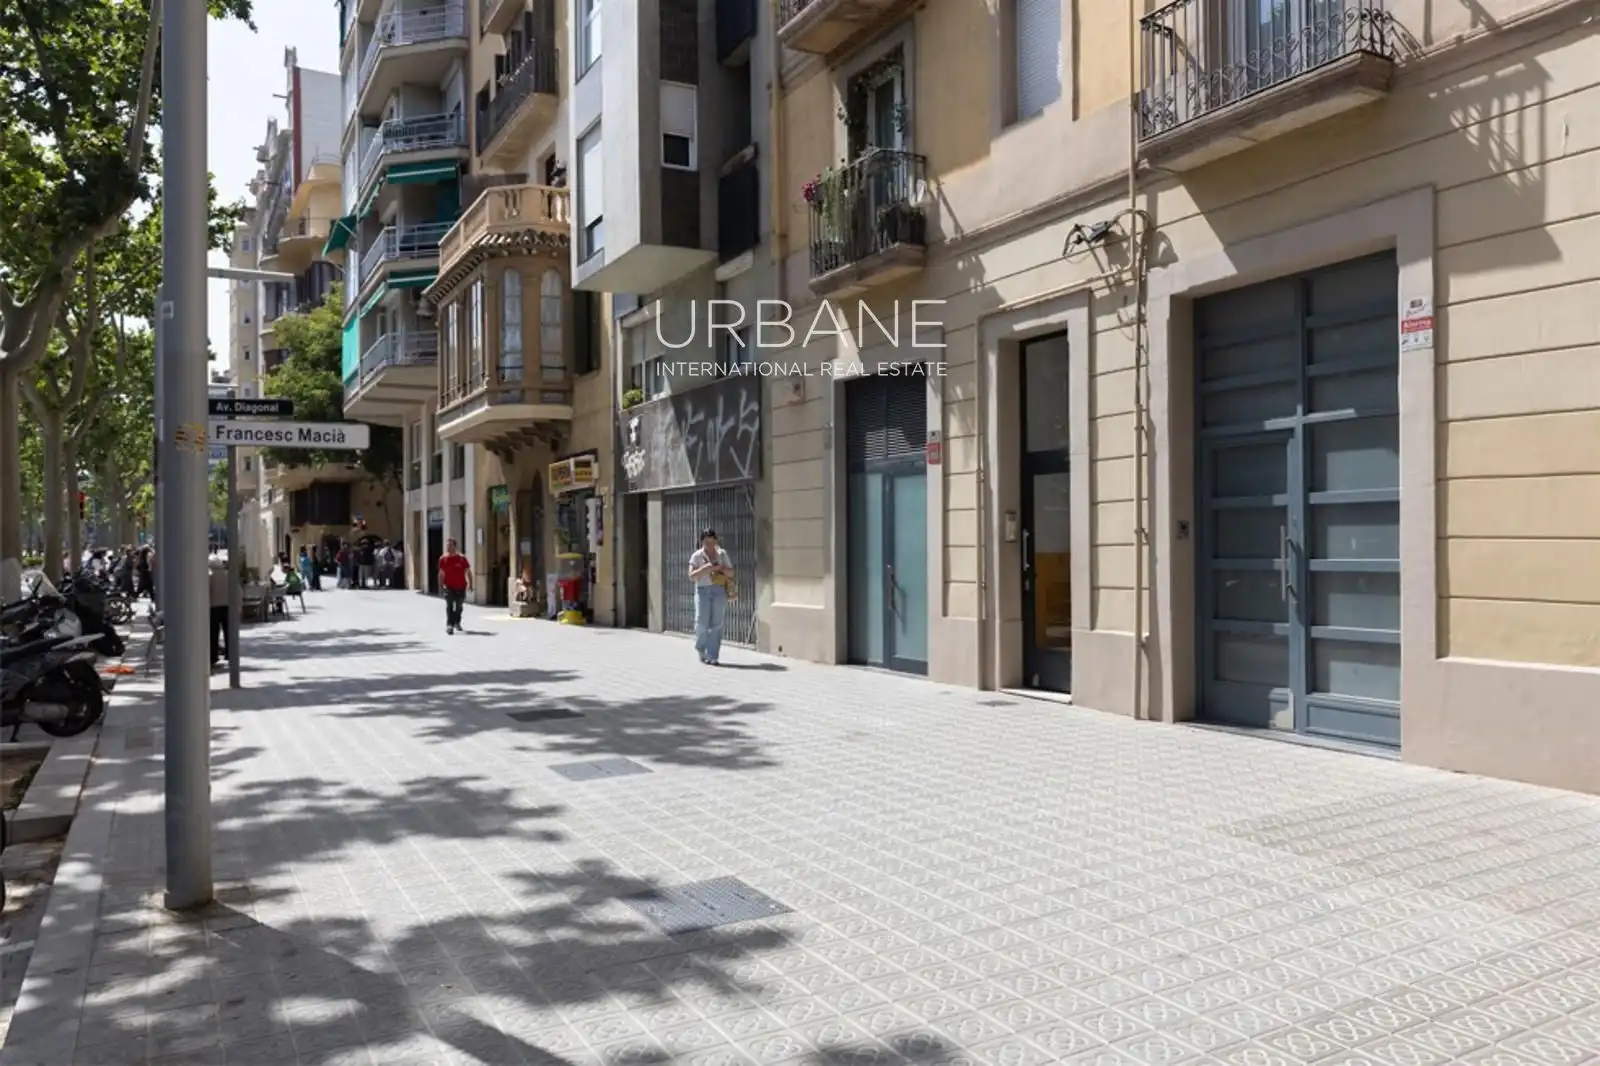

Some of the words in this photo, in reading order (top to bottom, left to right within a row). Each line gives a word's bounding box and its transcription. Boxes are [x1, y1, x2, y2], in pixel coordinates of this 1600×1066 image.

[216, 402, 232, 412] Av.
[234, 402, 280, 414] Diagonal
[216, 424, 293, 442] Francesc
[299, 427, 346, 444] Macià
